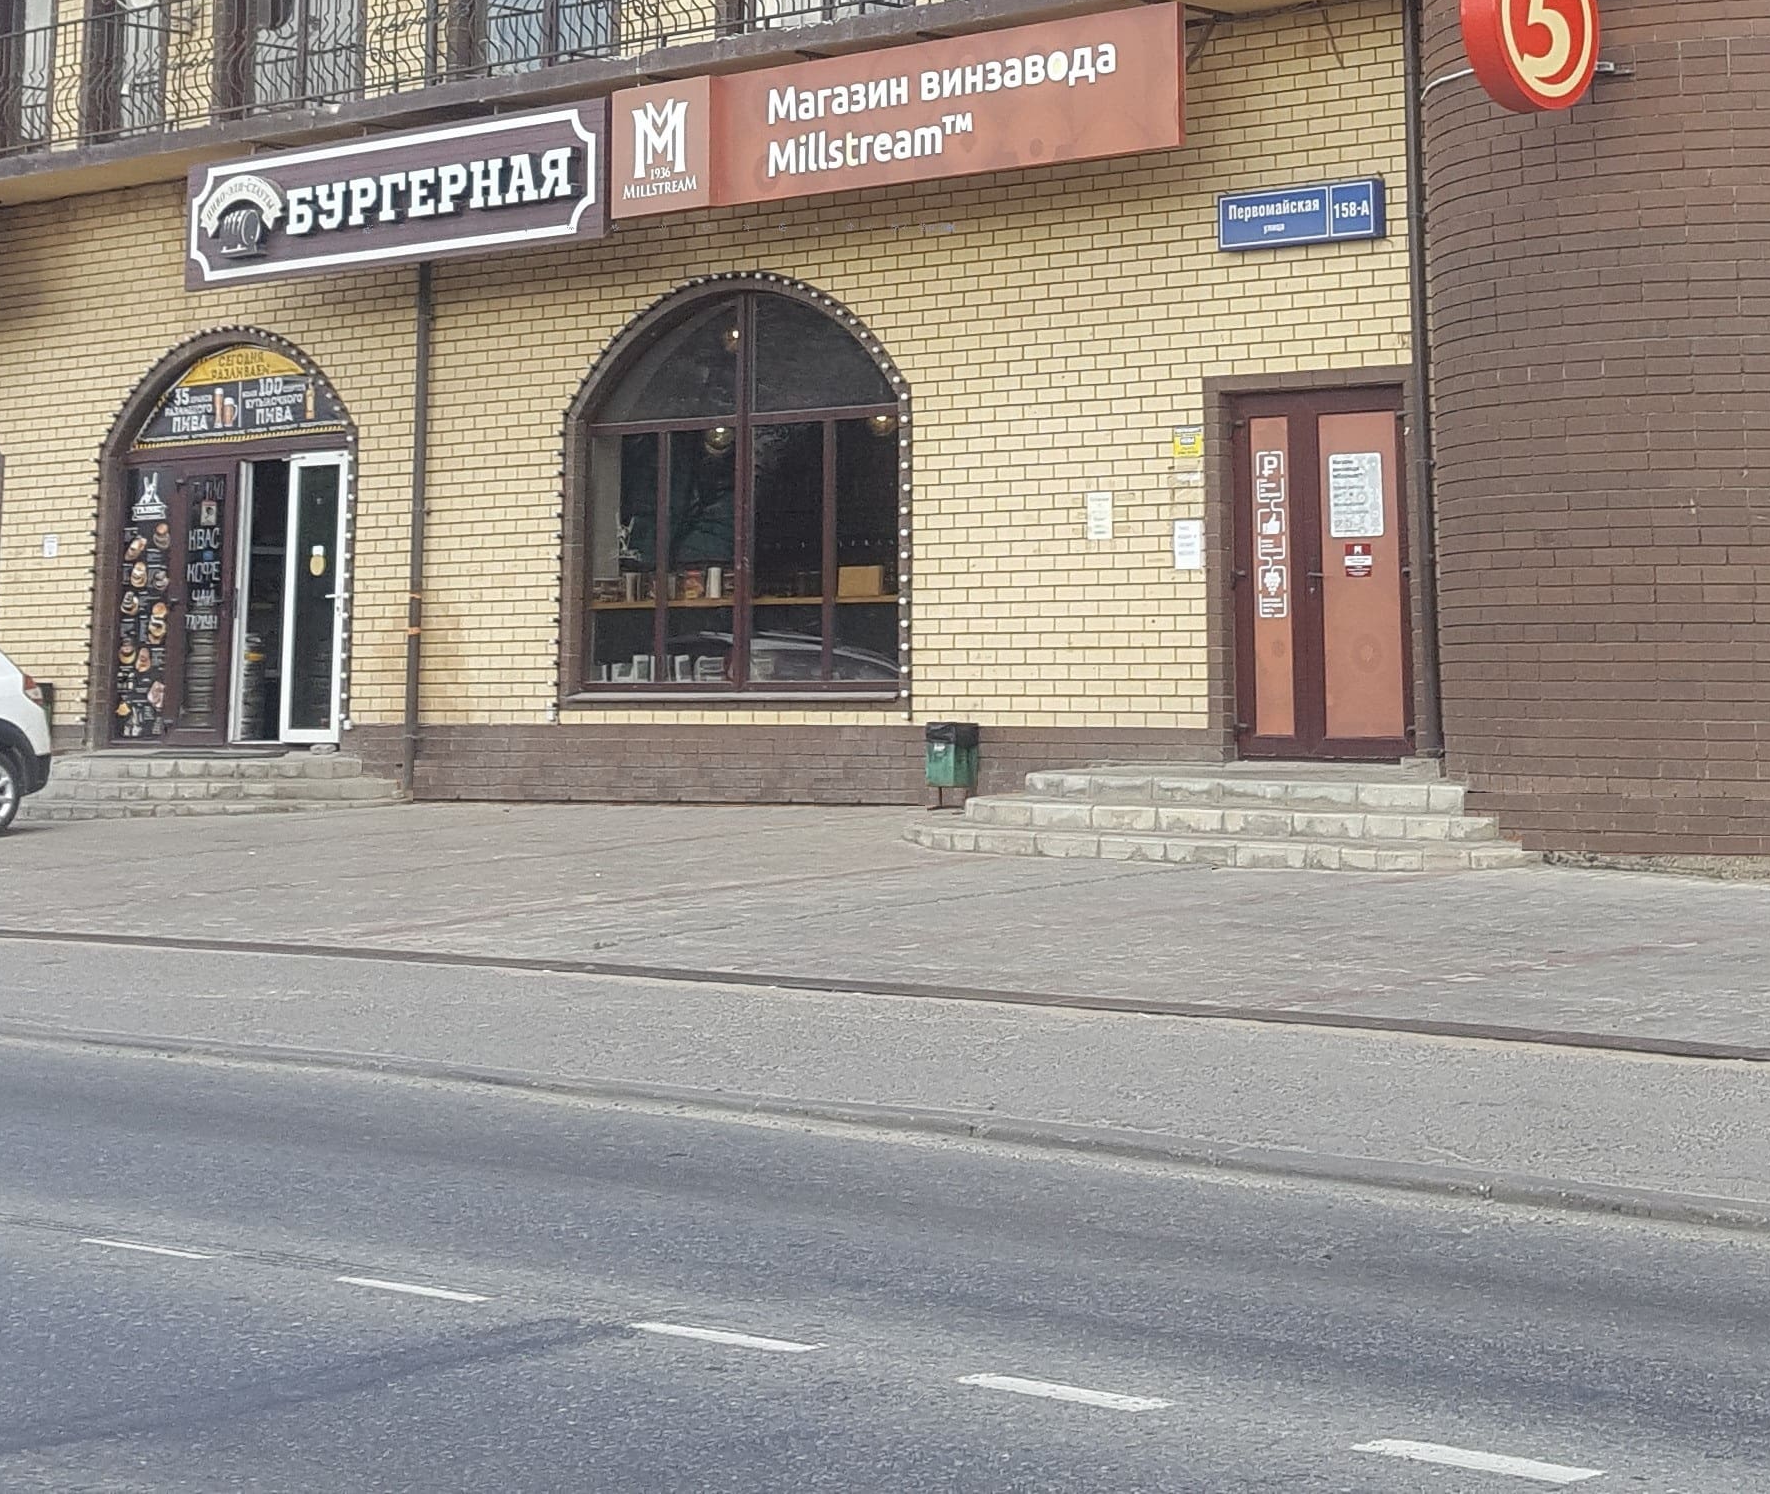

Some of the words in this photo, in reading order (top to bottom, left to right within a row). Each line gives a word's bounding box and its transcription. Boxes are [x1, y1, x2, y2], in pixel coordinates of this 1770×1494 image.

[767, 76, 909, 125] Магазин
[920, 42, 1117, 101] винзавода
[650, 166, 671, 181] 1936
[286, 146, 574, 236] БУРГЕРНАЯ
[1228, 198, 1320, 222] Первомайская
[1333, 200, 1370, 219] 158-А
[1263, 223, 1286, 234] улица
[258, 378, 283, 395] 100
[172, 415, 209, 433] ПИВА
[255, 407, 293, 425] ПИВА
[188, 527, 221, 551] КВАС
[187, 561, 221, 583] КОФЕ
